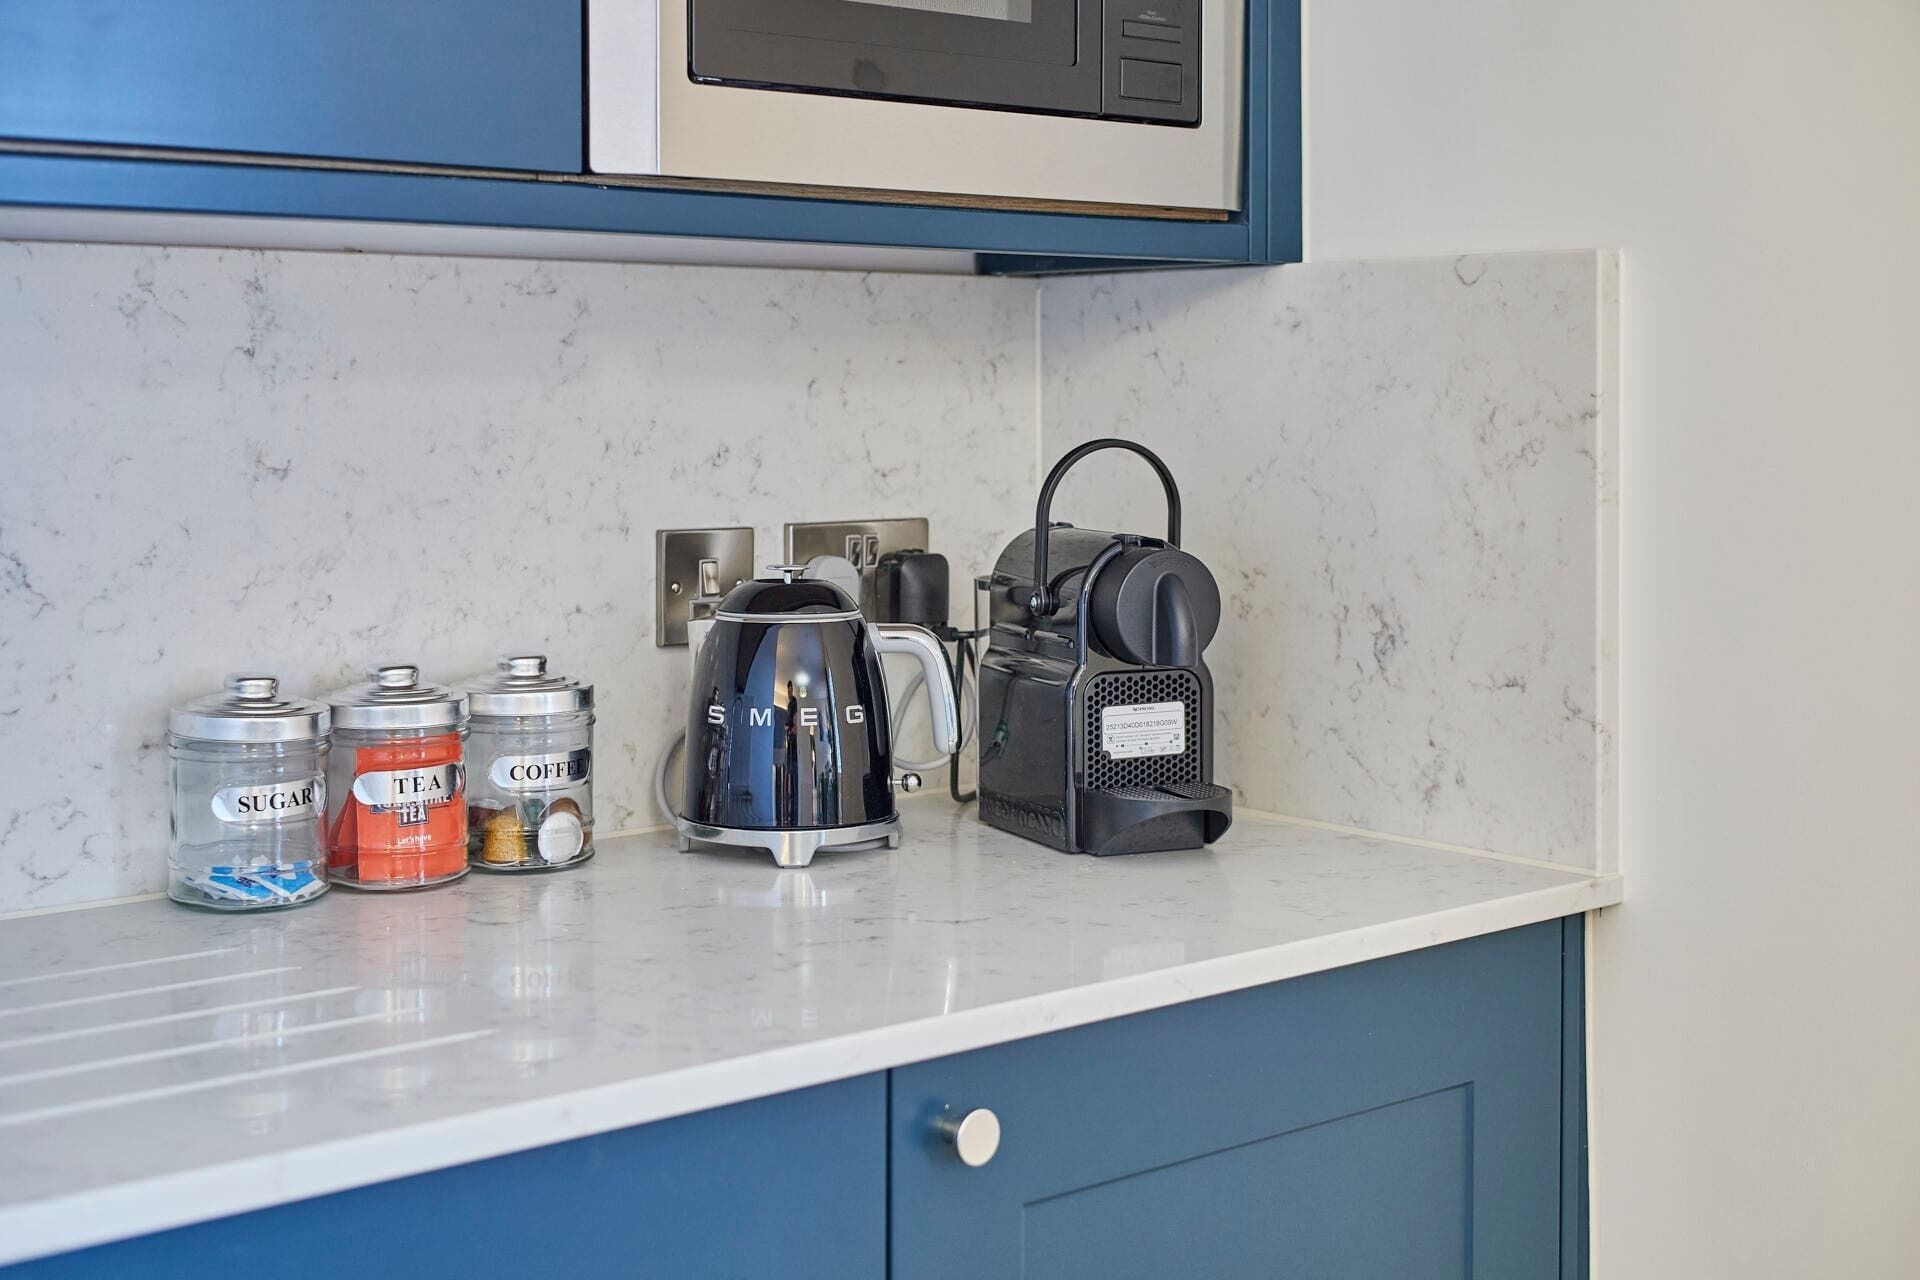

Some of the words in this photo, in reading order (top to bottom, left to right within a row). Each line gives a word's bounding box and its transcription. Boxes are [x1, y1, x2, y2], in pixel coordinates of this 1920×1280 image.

[707, 704, 865, 727] SMEG
[509, 757, 584, 782] COFFEE
[394, 774, 442, 794] TEA
[238, 787, 314, 814] SUGAR
[401, 805, 426, 823] TEA
